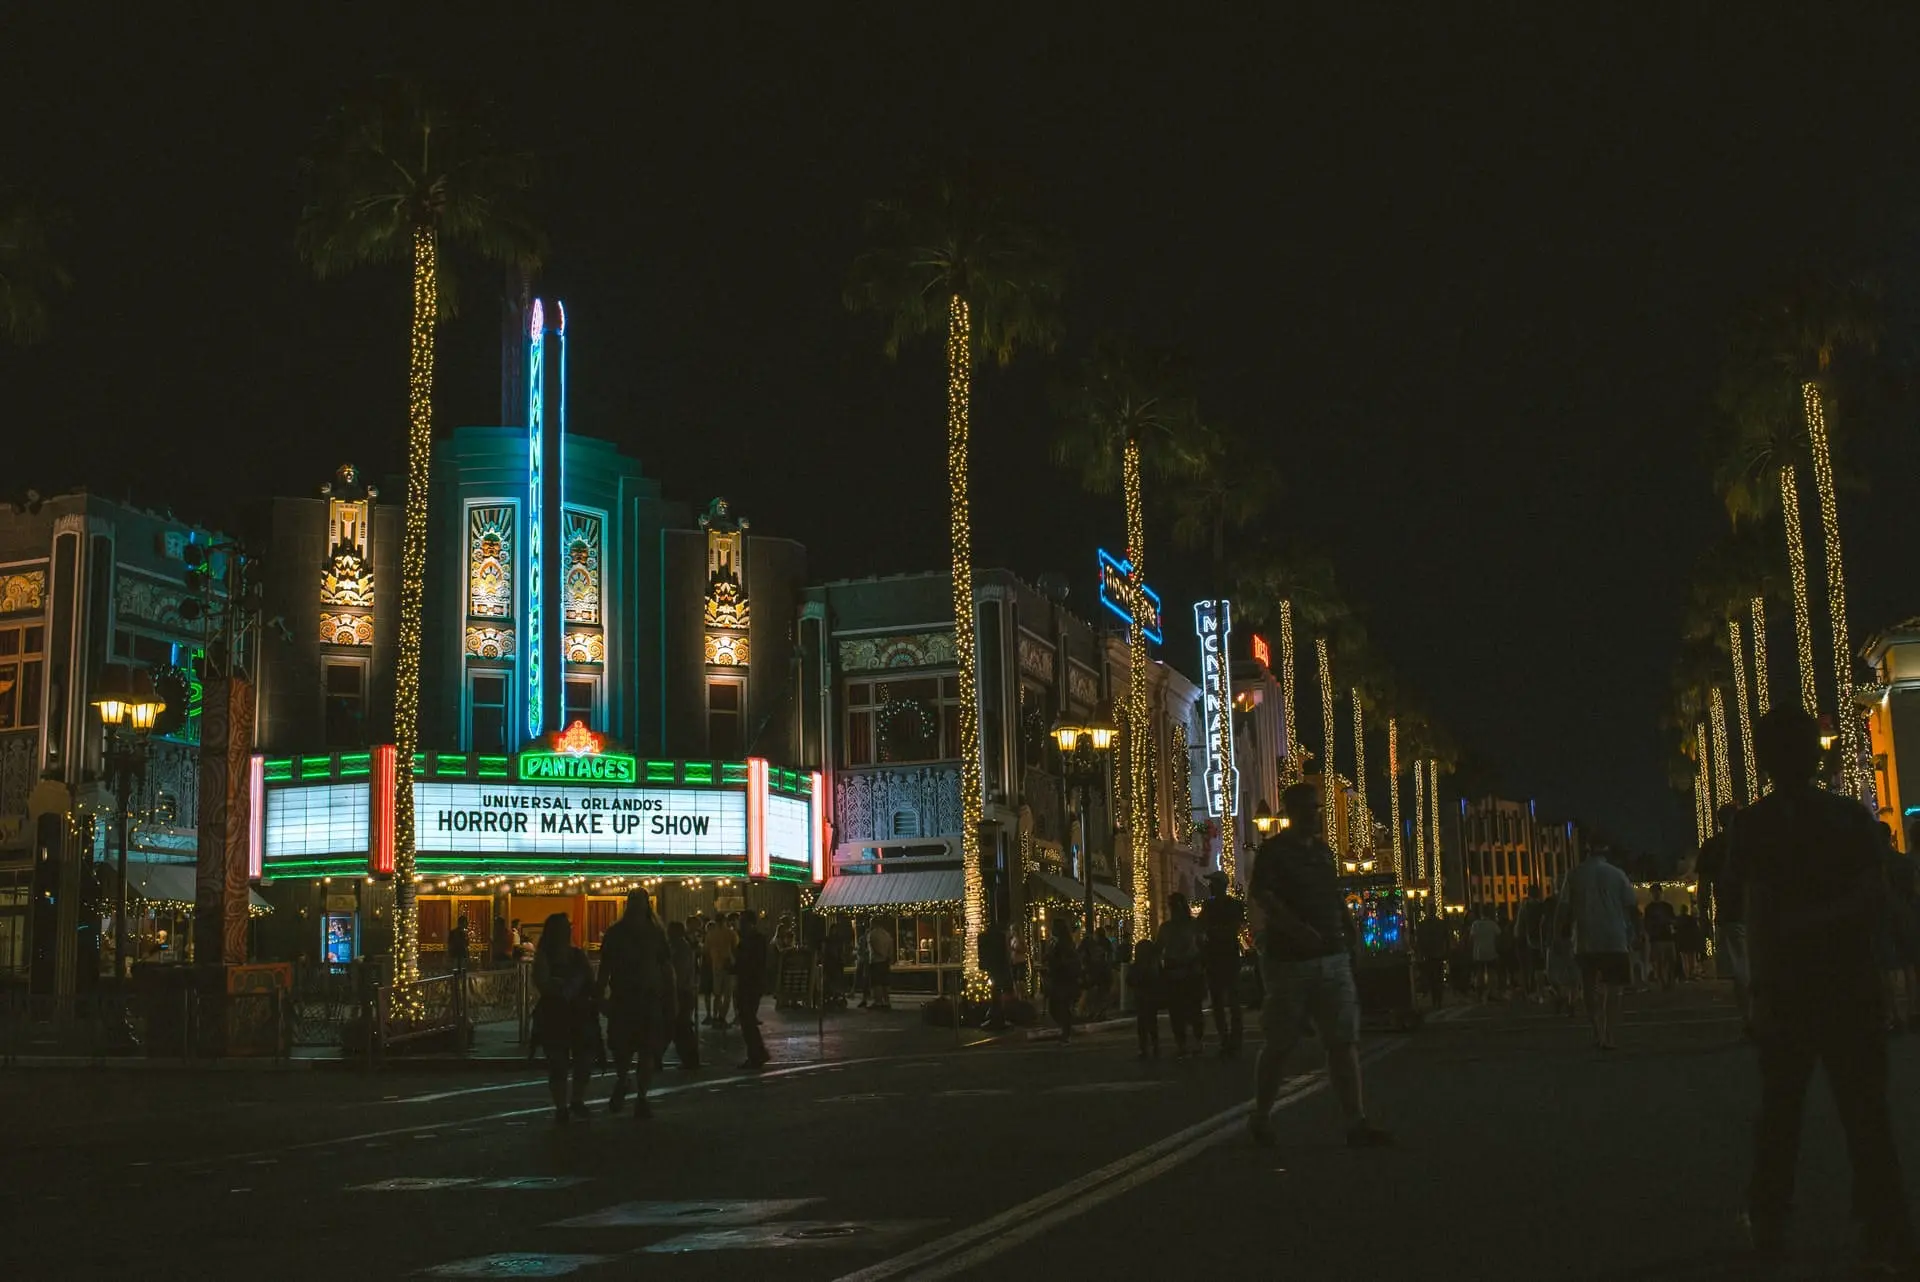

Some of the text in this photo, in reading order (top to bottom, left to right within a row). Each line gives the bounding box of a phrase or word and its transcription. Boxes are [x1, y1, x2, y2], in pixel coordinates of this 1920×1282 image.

[527, 757, 630, 779] PANTAGES
[483, 795, 663, 812] UNIVERSAL ORLANDO'S
[438, 810, 710, 836] HORROR MAKE UP SHOW
